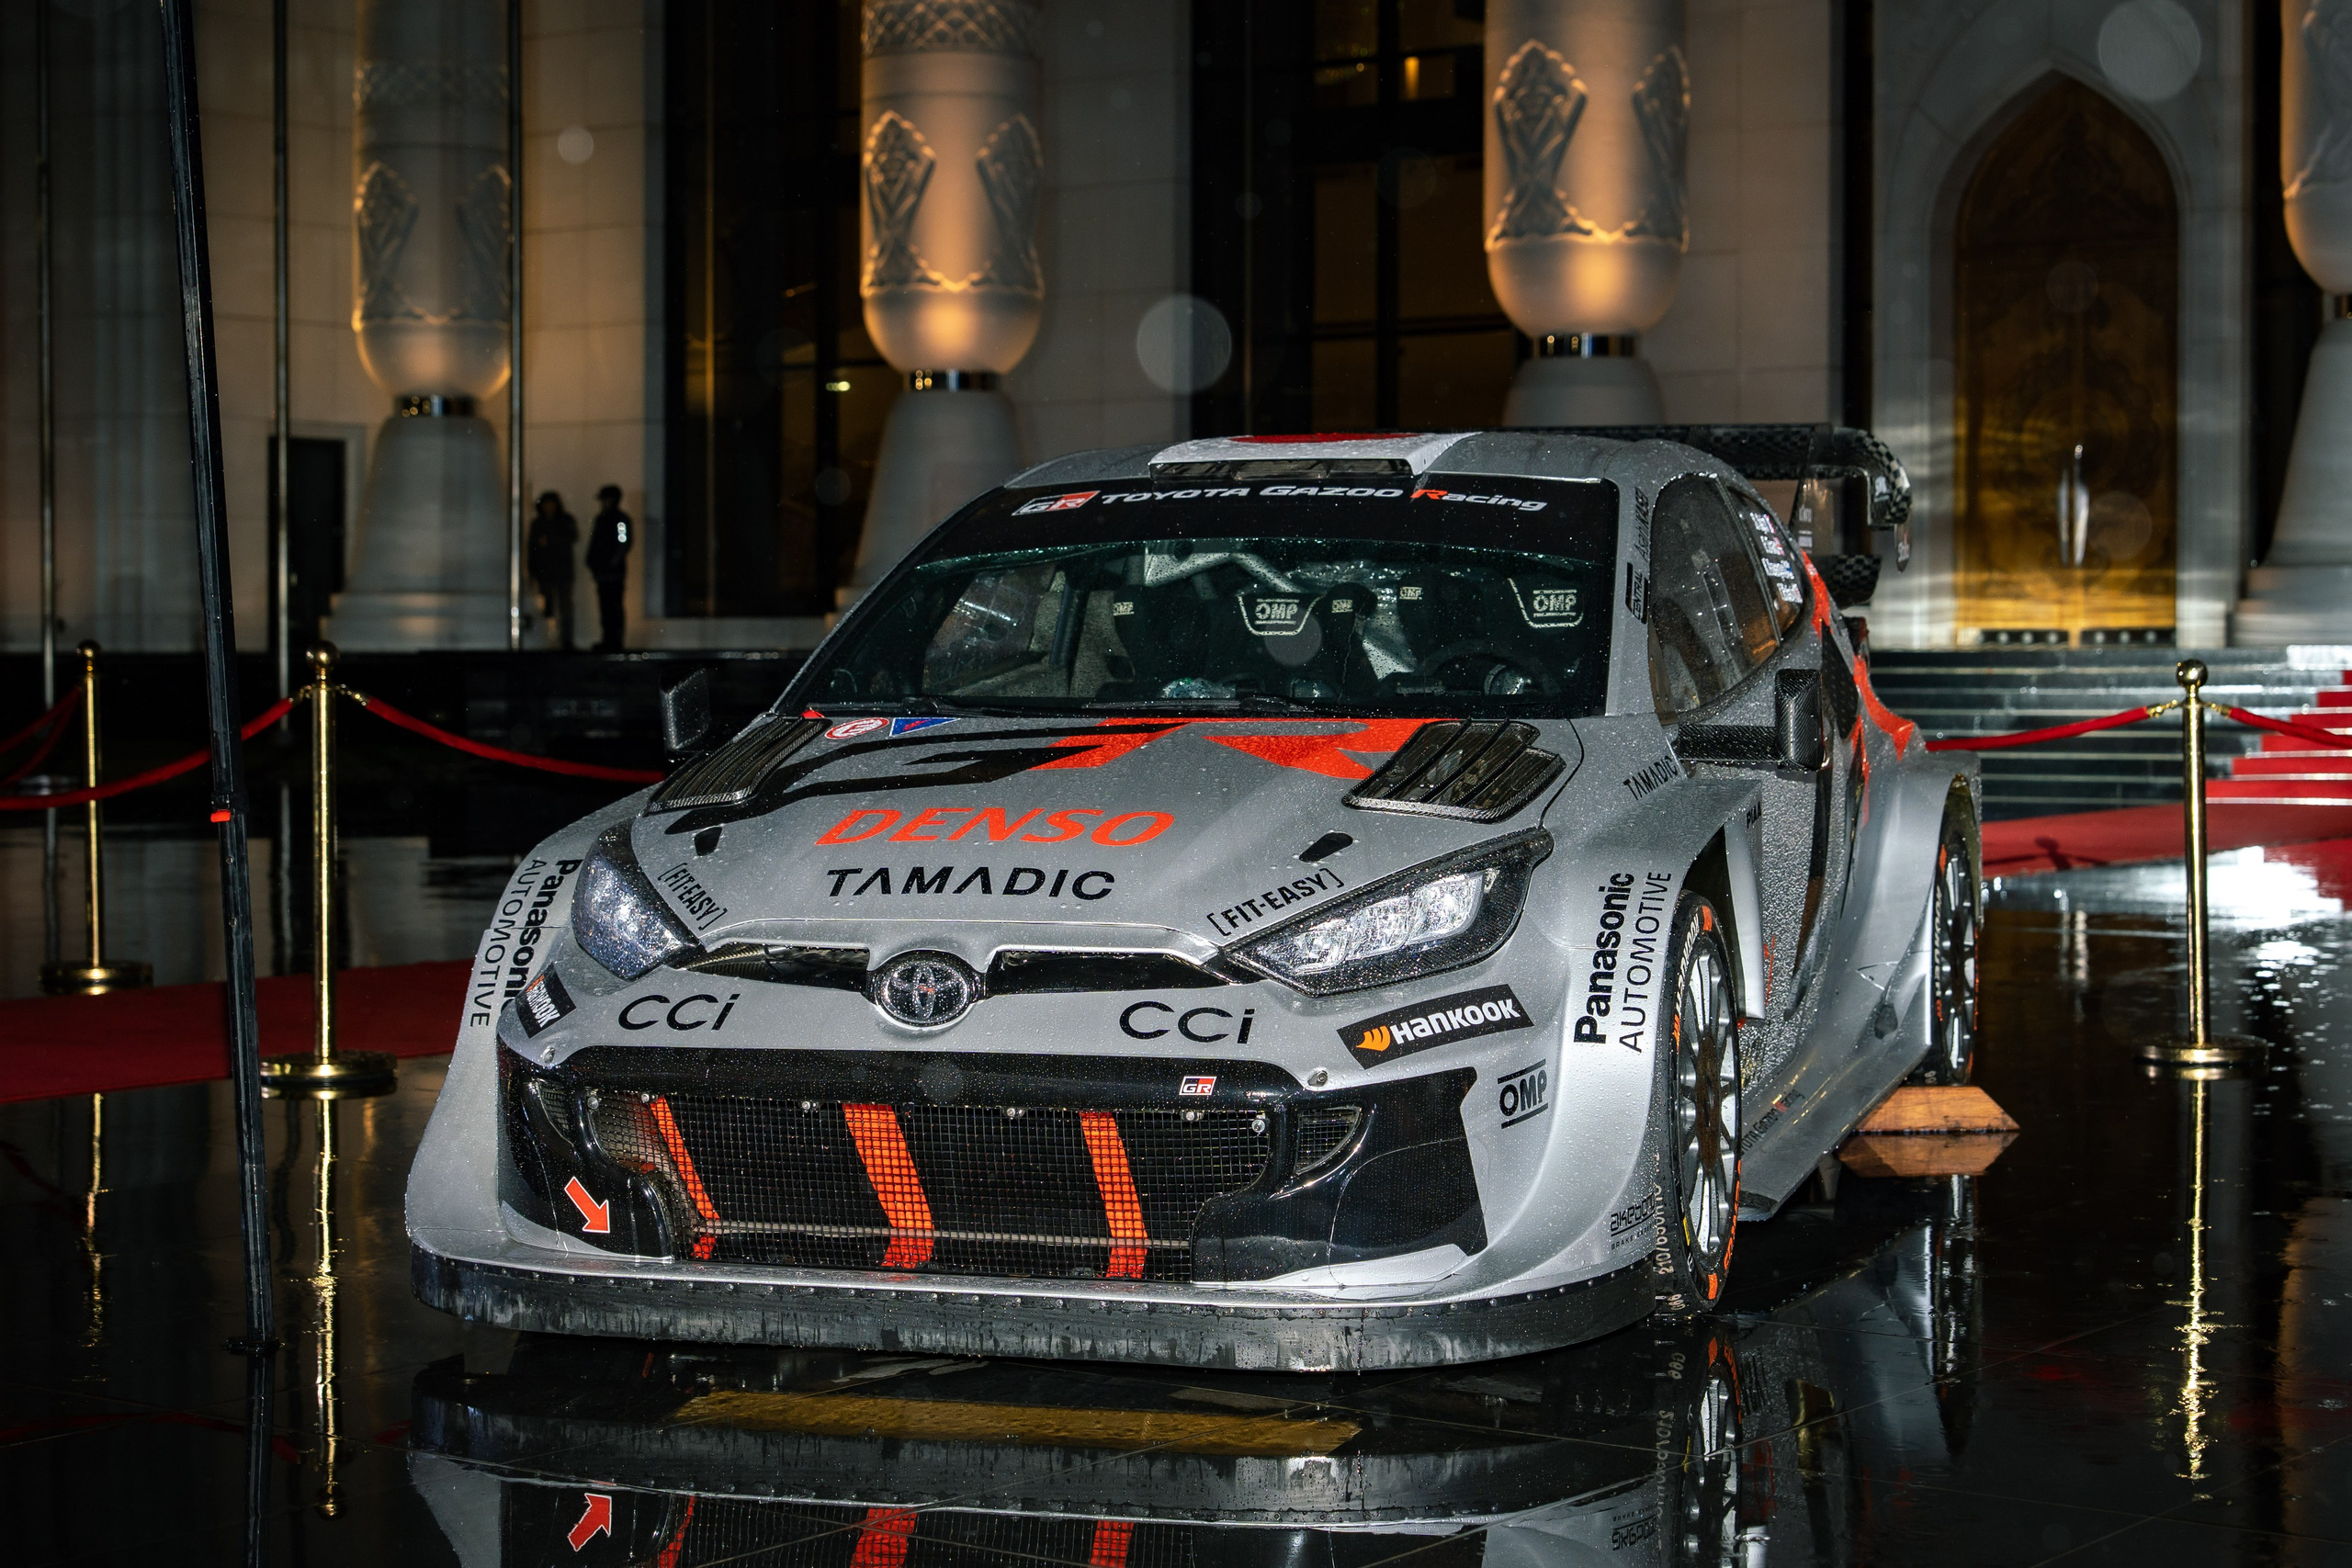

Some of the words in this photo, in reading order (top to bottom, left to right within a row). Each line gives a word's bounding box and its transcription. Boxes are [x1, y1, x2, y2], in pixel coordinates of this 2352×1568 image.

[1016, 494, 1087, 514] GR
[1102, 488, 1249, 504] TOYOTA
[1260, 486, 1404, 498] GAZOO
[1410, 489, 1548, 511] Racing
[1256, 603, 1298, 621] OMP
[1533, 593, 1577, 613] OMP
[1633, 571, 1643, 620] CENTRAL
[1623, 755, 1680, 801] TAMADIC
[815, 807, 1176, 847] DENSO
[827, 866, 1115, 901] TAMADIC
[470, 859, 548, 1027] AUTOMOTIVE
[501, 859, 582, 1013] Panasoni
[1574, 873, 1635, 1044] Panasonic
[1619, 872, 1672, 1054] AUTOMOTIVE
[1182, 1081, 1216, 1094] GR
[1499, 1070, 1548, 1118] OMP
[1611, 1236, 1634, 1250] BRAKE
